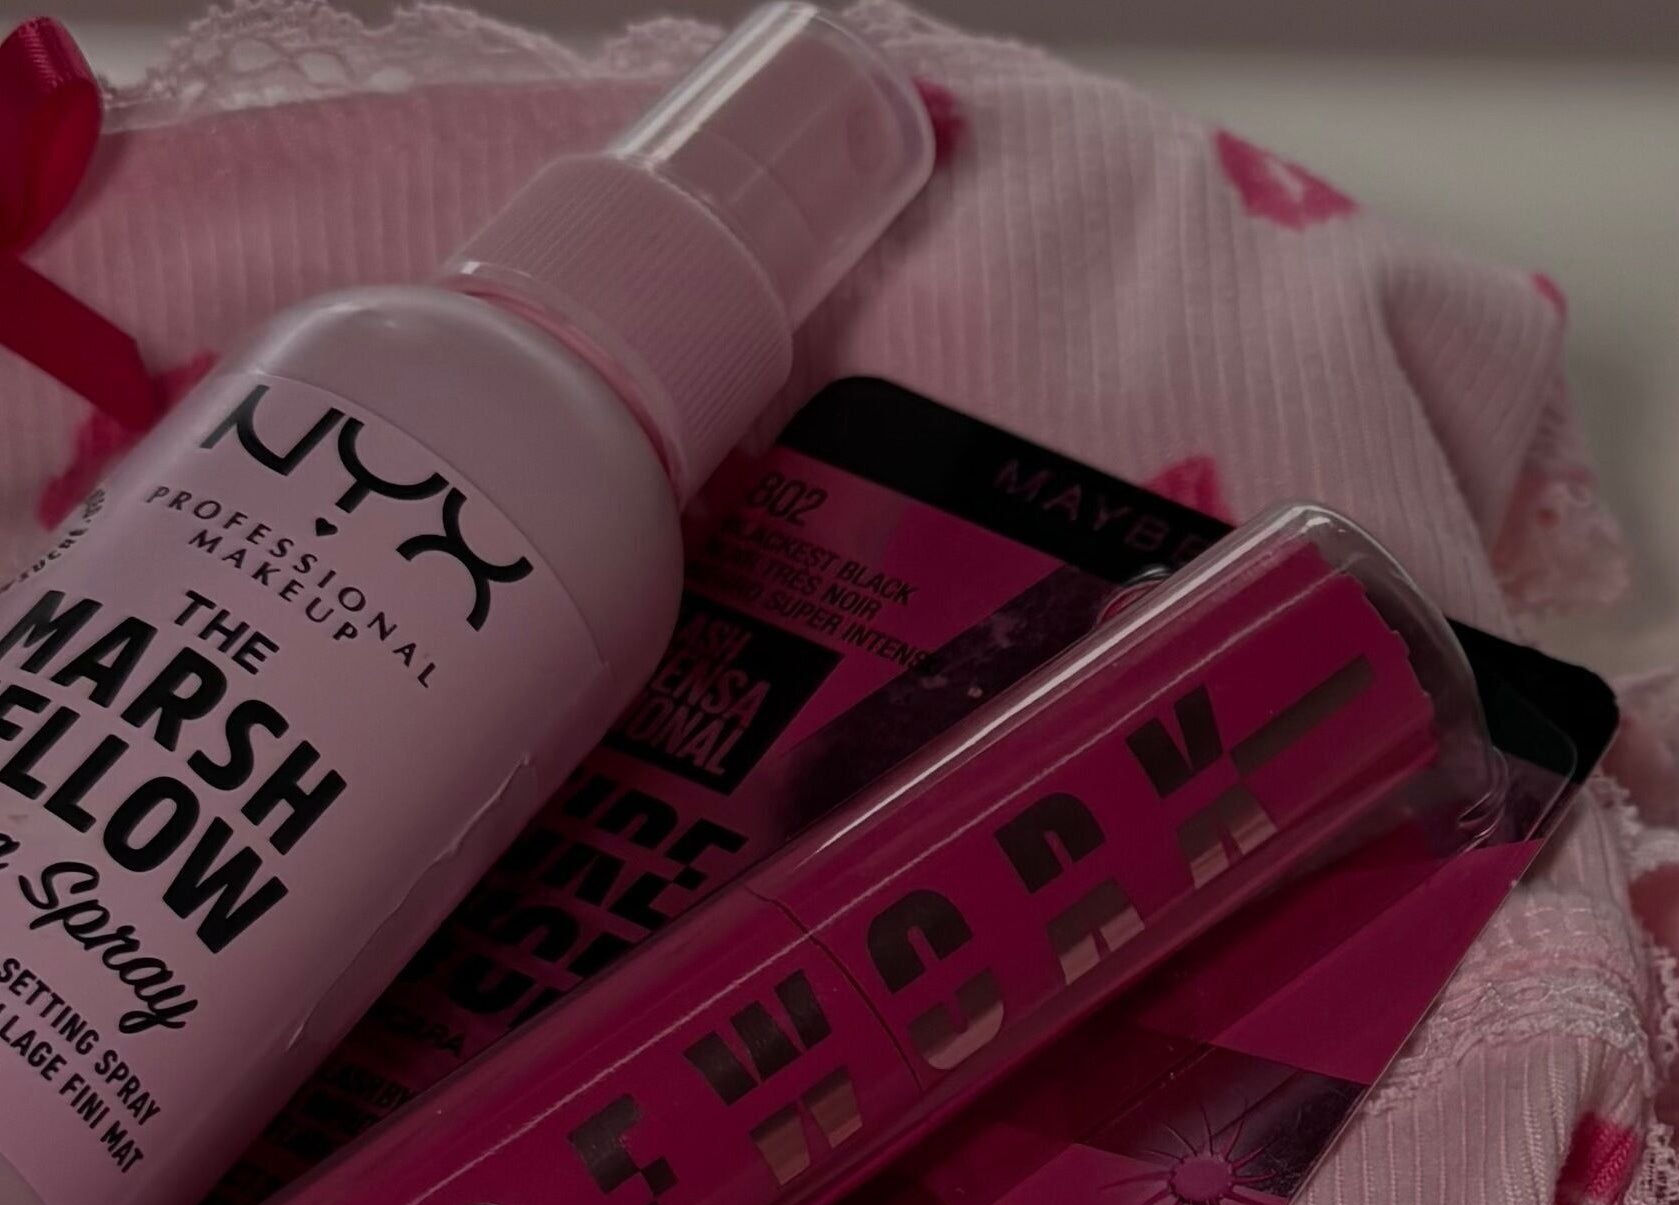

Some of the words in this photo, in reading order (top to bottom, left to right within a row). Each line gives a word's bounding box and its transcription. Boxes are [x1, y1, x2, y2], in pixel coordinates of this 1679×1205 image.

[200, 384, 533, 631] NYX
[749, 472, 829, 527] 802
[146, 485, 436, 688] PROFESSIONAL
[174, 589, 280, 675] THE
[188, 529, 358, 641] MAKEUP
[763, 590, 844, 636] SUPER
[820, 582, 883, 622] NOIR
[836, 560, 920, 605] BLACK
[0, 589, 347, 856] MARSH
[18, 861, 198, 1035] Spray
[0, 957, 100, 1056] SETTING
[95, 1049, 161, 1126] SPRAY
[59, 1073, 110, 1129] FINI
[100, 1120, 145, 1173] MAT
